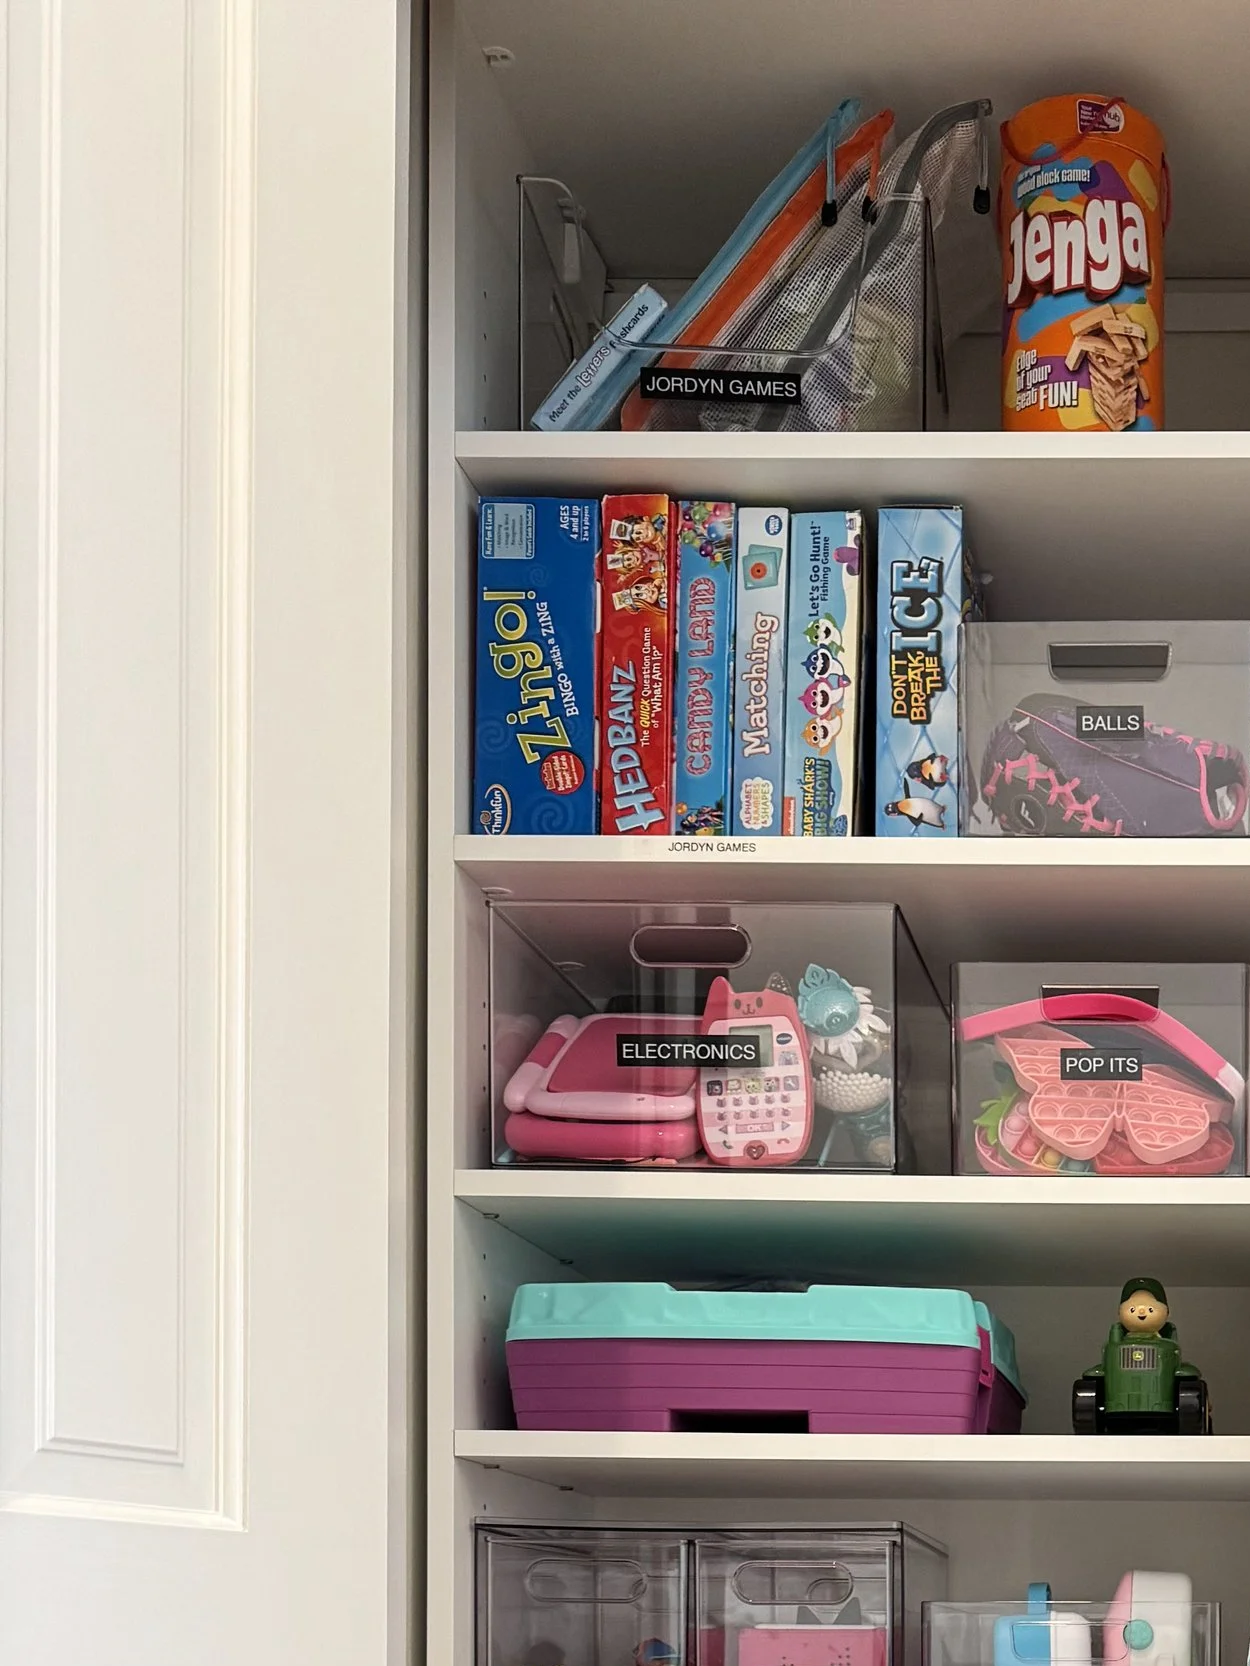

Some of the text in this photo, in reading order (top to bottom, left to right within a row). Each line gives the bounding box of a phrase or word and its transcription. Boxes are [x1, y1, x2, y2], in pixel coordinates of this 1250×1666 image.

[1007, 197, 1149, 302] Jenga
[1016, 349, 1037, 373] Edge
[1027, 364, 1051, 388] your
[549, 399, 570, 423] Meet
[567, 384, 582, 401] the
[576, 345, 611, 387] Letters
[647, 377, 796, 397] JORDYN GAMES
[1016, 381, 1078, 411] seat FUN!
[560, 505, 570, 529] AGES
[570, 505, 581, 540] 4 and up
[808, 525, 821, 617] Let's Go Hunt!
[820, 536, 832, 602] Fishing Game
[891, 558, 940, 652] ICE
[483, 590, 572, 765] Zingo!
[536, 601, 579, 717] BINGO with a ZING
[652, 662, 661, 679] Am
[685, 577, 716, 776] CANDY LAND
[926, 656, 941, 694] THE
[640, 627, 651, 747] The QUICK Question Game
[741, 612, 780, 757] Matching
[891, 654, 908, 715] DON'T
[907, 651, 927, 721] BREAK
[653, 718, 659, 729] of
[1082, 715, 1139, 730] BALLS
[607, 660, 666, 832] HEDBANZ
[744, 784, 752, 825] ALPHABET
[753, 782, 761, 825] NUMBERS
[803, 758, 816, 837] BABY SHARK'S
[668, 842, 756, 852] JORDYN GAMES
[623, 1044, 755, 1059] ELECTRONICS
[1067, 1058, 1138, 1072] POP ITS
